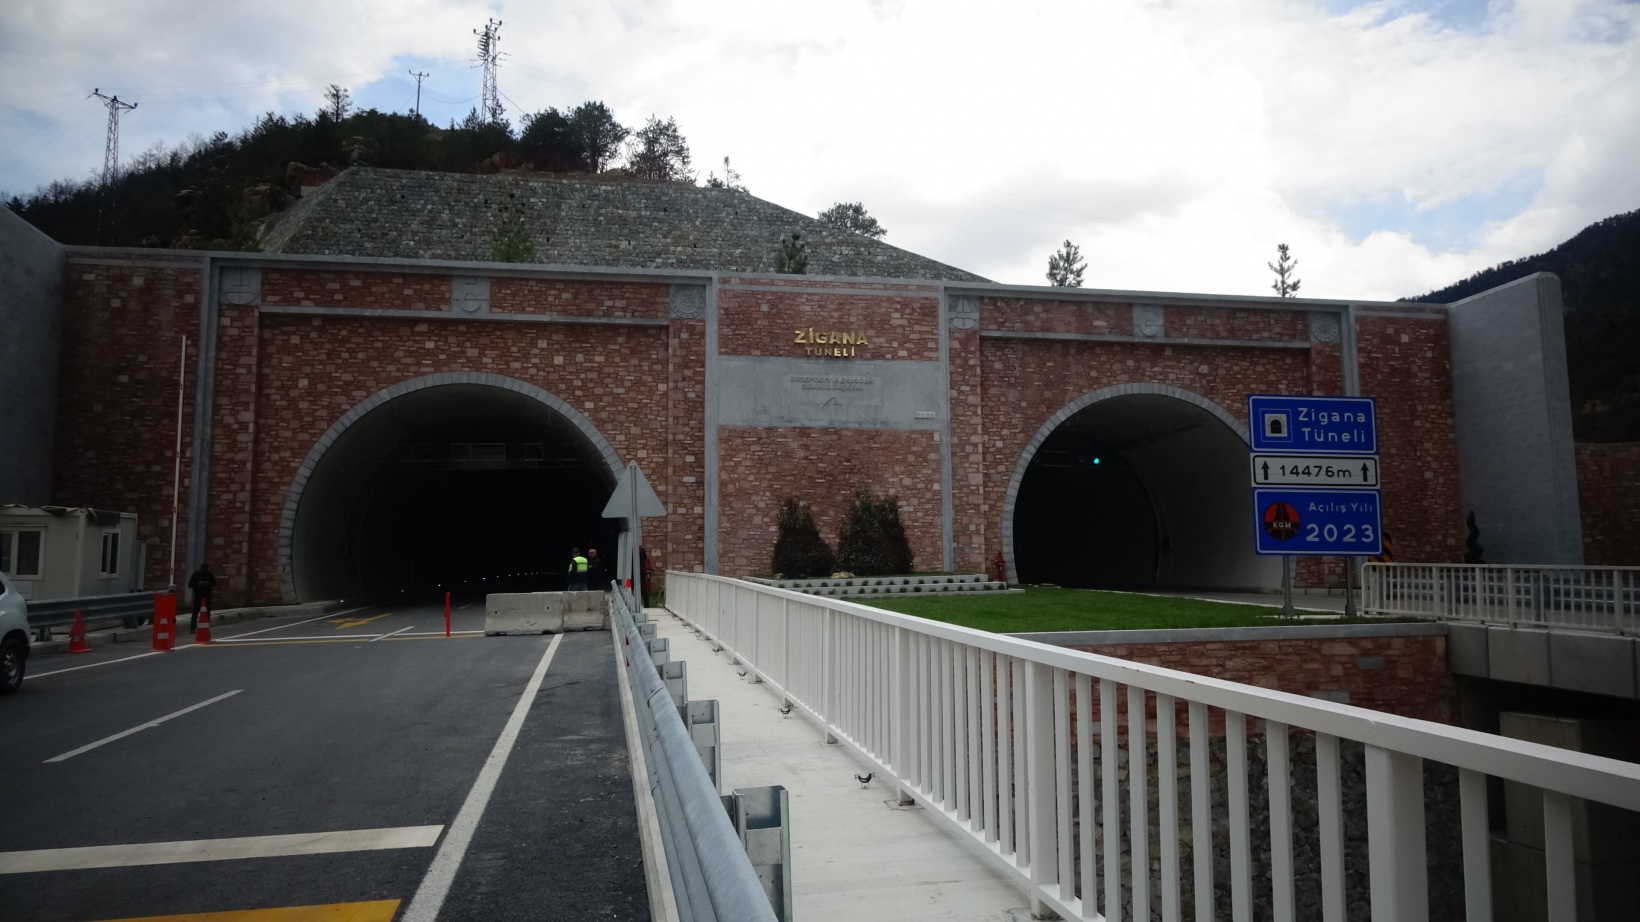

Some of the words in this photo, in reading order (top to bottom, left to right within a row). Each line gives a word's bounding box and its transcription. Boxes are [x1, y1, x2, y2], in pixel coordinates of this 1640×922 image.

[794, 328, 868, 345] ZİGANA
[1298, 408, 1366, 425] Zigana
[1302, 427, 1365, 442] Tüneli
[1280, 465, 1352, 478] 14476m
[1308, 502, 1346, 513] Açılış
[1350, 503, 1373, 512] Yılı
[1306, 523, 1374, 542] 2023
